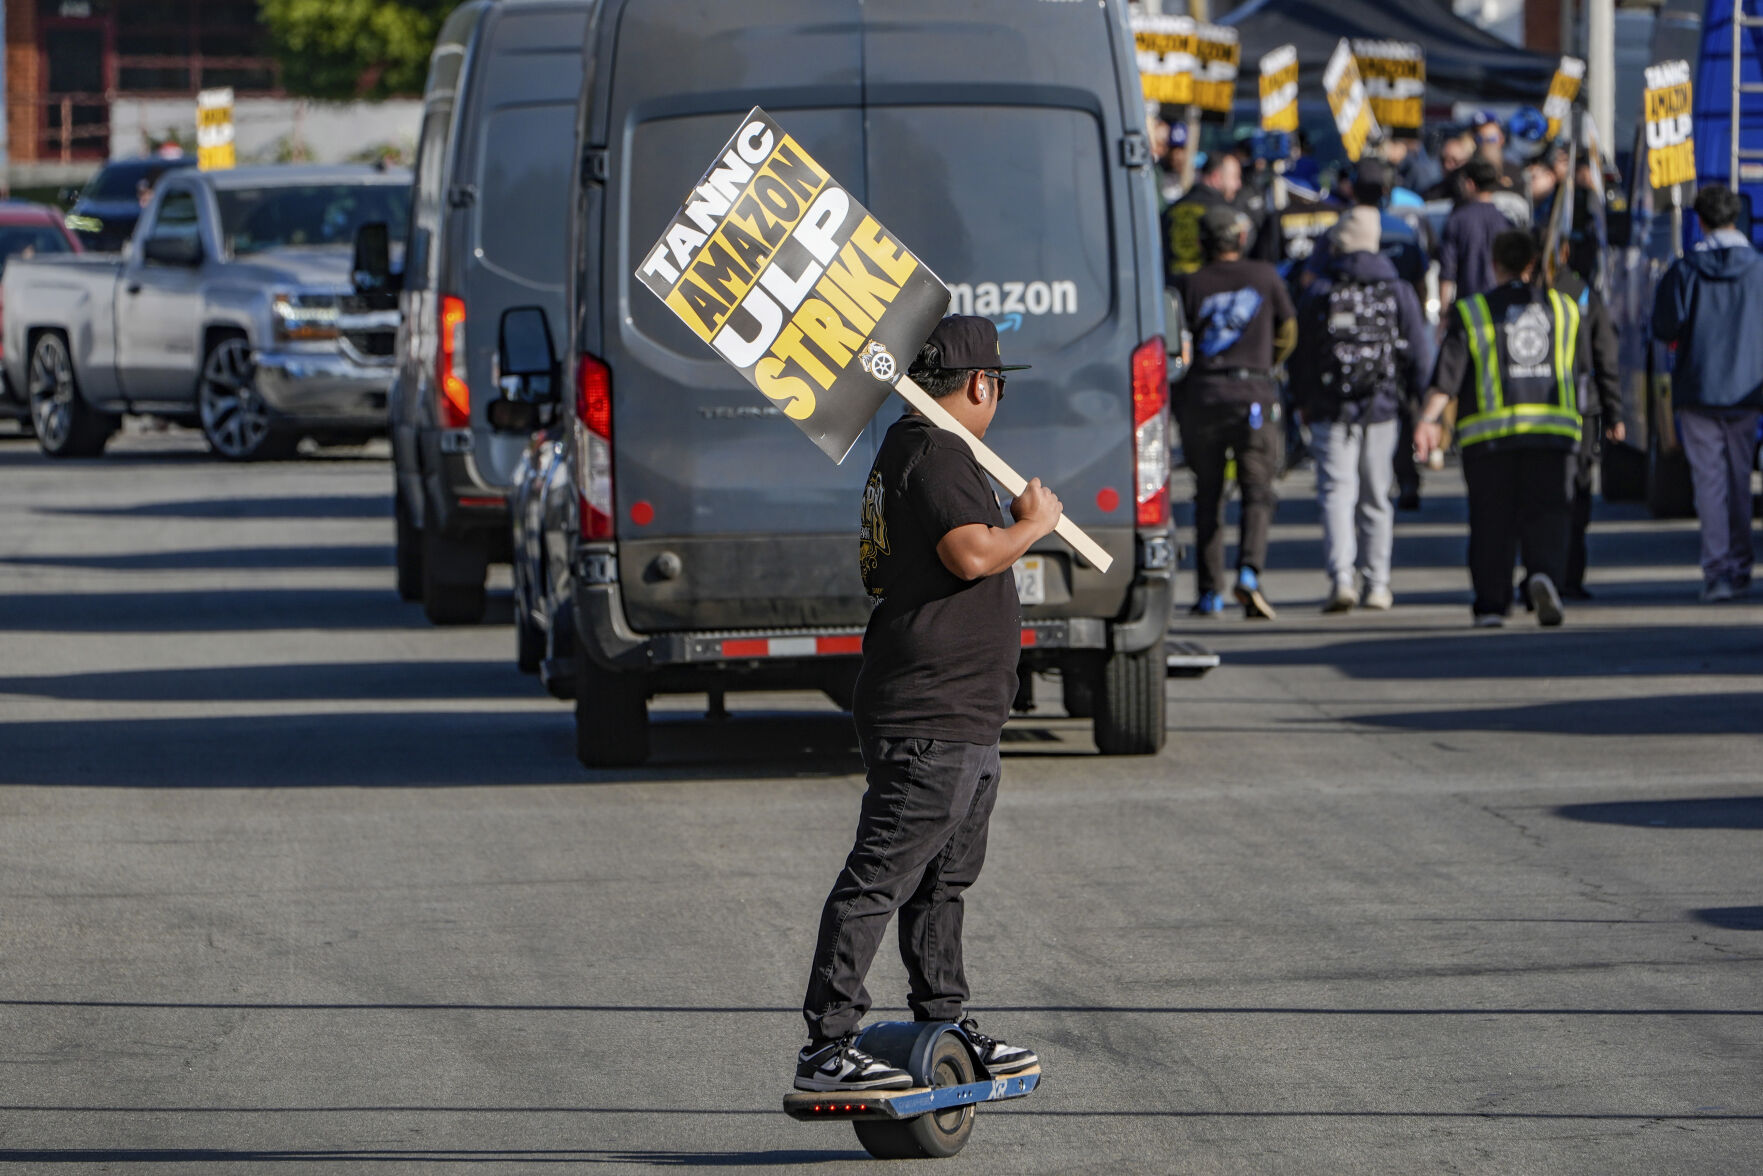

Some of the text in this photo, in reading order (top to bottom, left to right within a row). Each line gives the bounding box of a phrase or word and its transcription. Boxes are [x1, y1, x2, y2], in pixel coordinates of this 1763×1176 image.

[1645, 113, 1692, 150] ULP
[677, 145, 823, 333] AMAZON
[711, 186, 850, 368] ULP
[754, 214, 919, 420] STRIKE
[946, 280, 1079, 316] mazon
[987, 1079, 1008, 1100] XR
